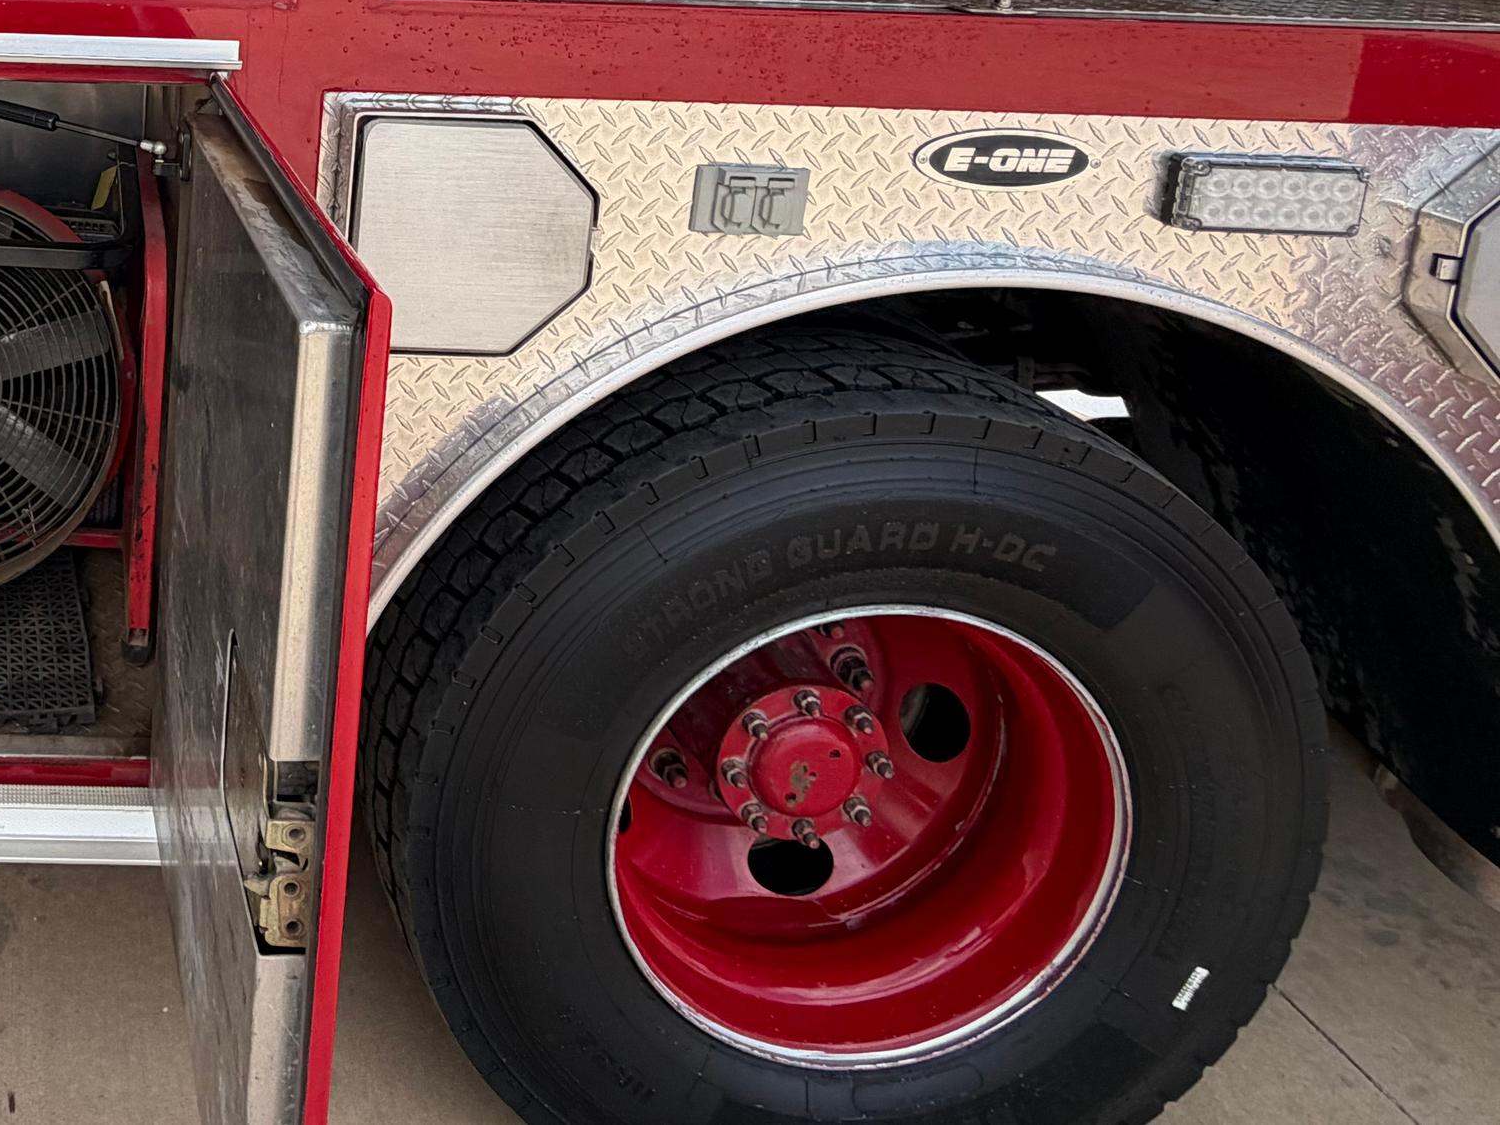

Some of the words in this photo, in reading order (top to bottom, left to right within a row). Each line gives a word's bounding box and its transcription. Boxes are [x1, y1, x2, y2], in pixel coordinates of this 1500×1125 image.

[943, 147, 1076, 173] E-ONE
[787, 520, 940, 567] GUARD
[949, 522, 1057, 572] H-DC
